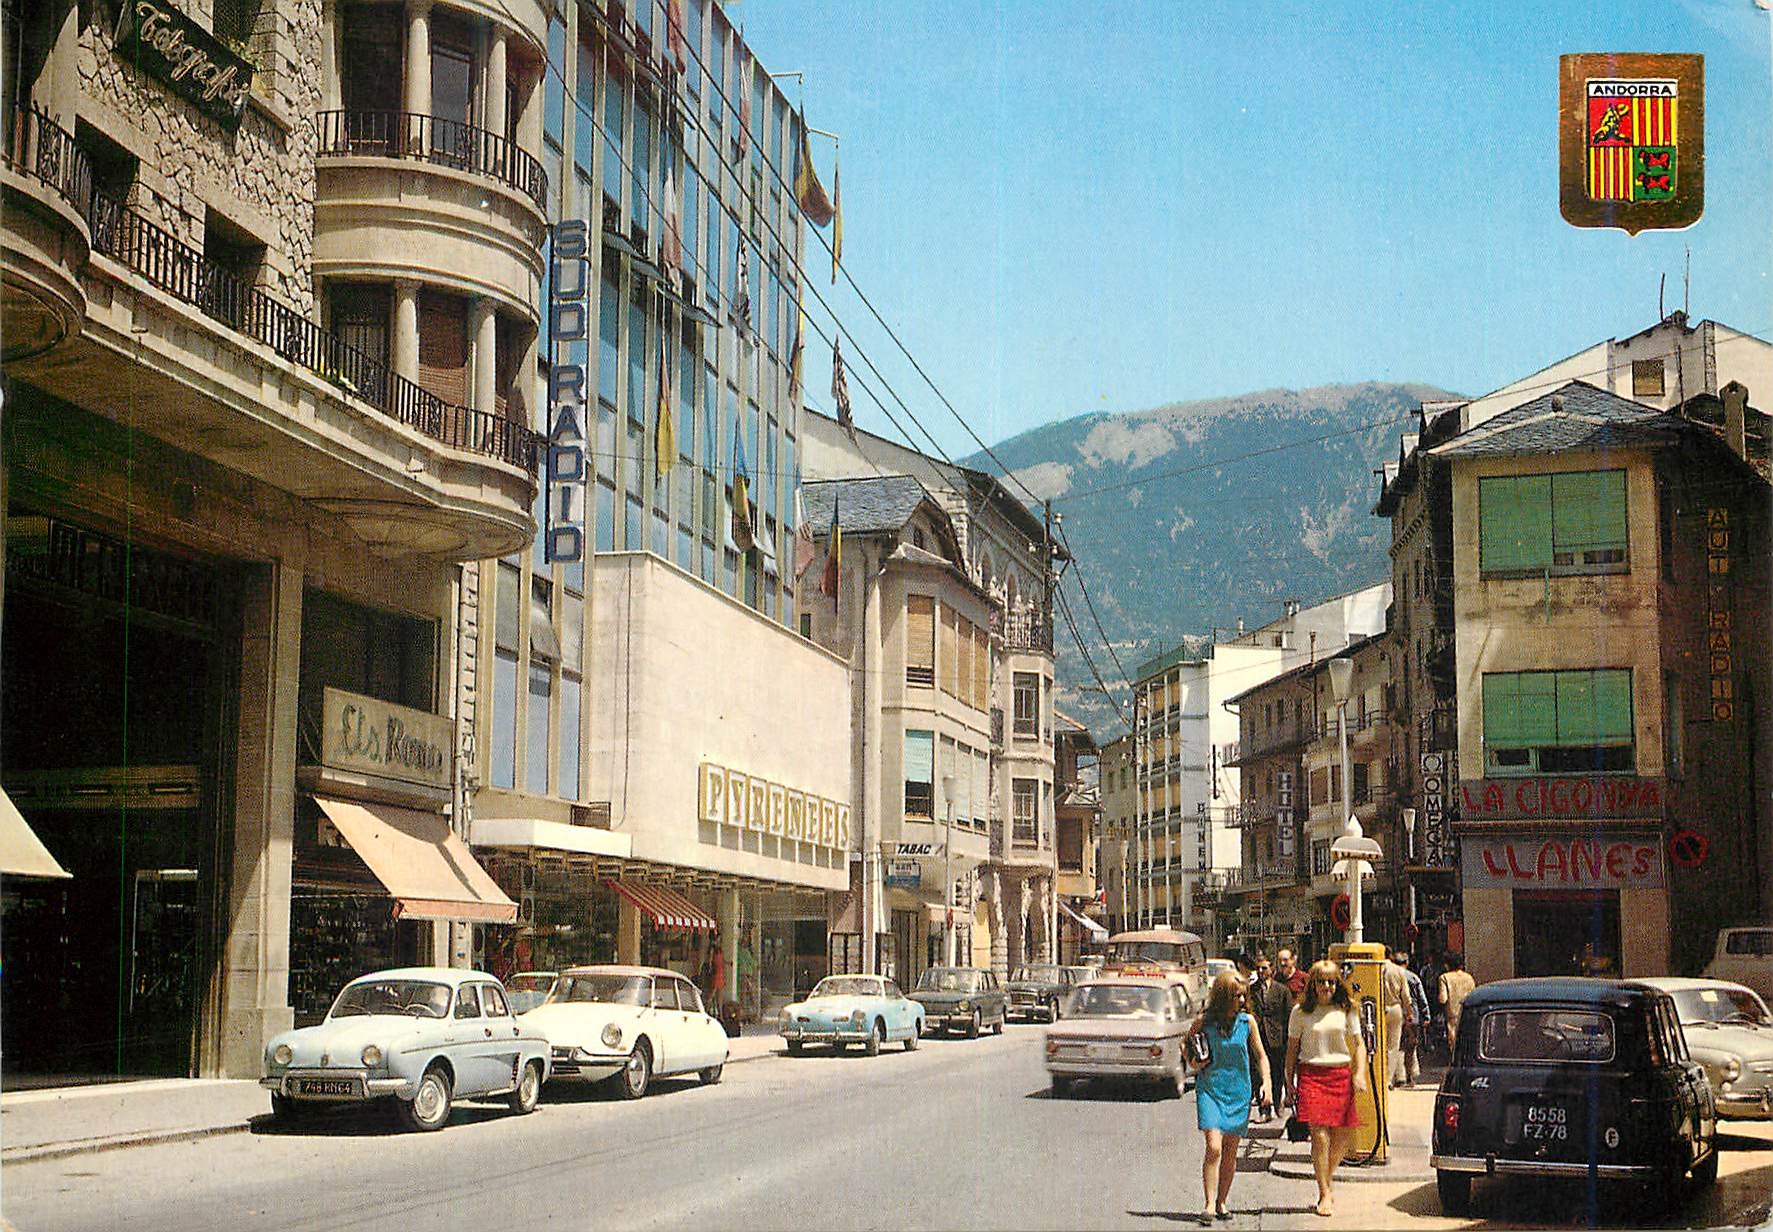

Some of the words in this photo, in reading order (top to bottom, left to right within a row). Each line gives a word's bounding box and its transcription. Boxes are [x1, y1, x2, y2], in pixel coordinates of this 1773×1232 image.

[553, 219, 588, 341] SUD
[550, 363, 586, 562] RADIO
[1709, 611, 1733, 722] RADIO
[708, 771, 850, 849] PYRENEES
[1424, 776, 1444, 866] OMEGA
[1461, 783, 1505, 815] LA
[897, 843, 931, 855] TABAC
[1482, 838, 1656, 882] LLANES
[1528, 1105, 1567, 1123] 8558
